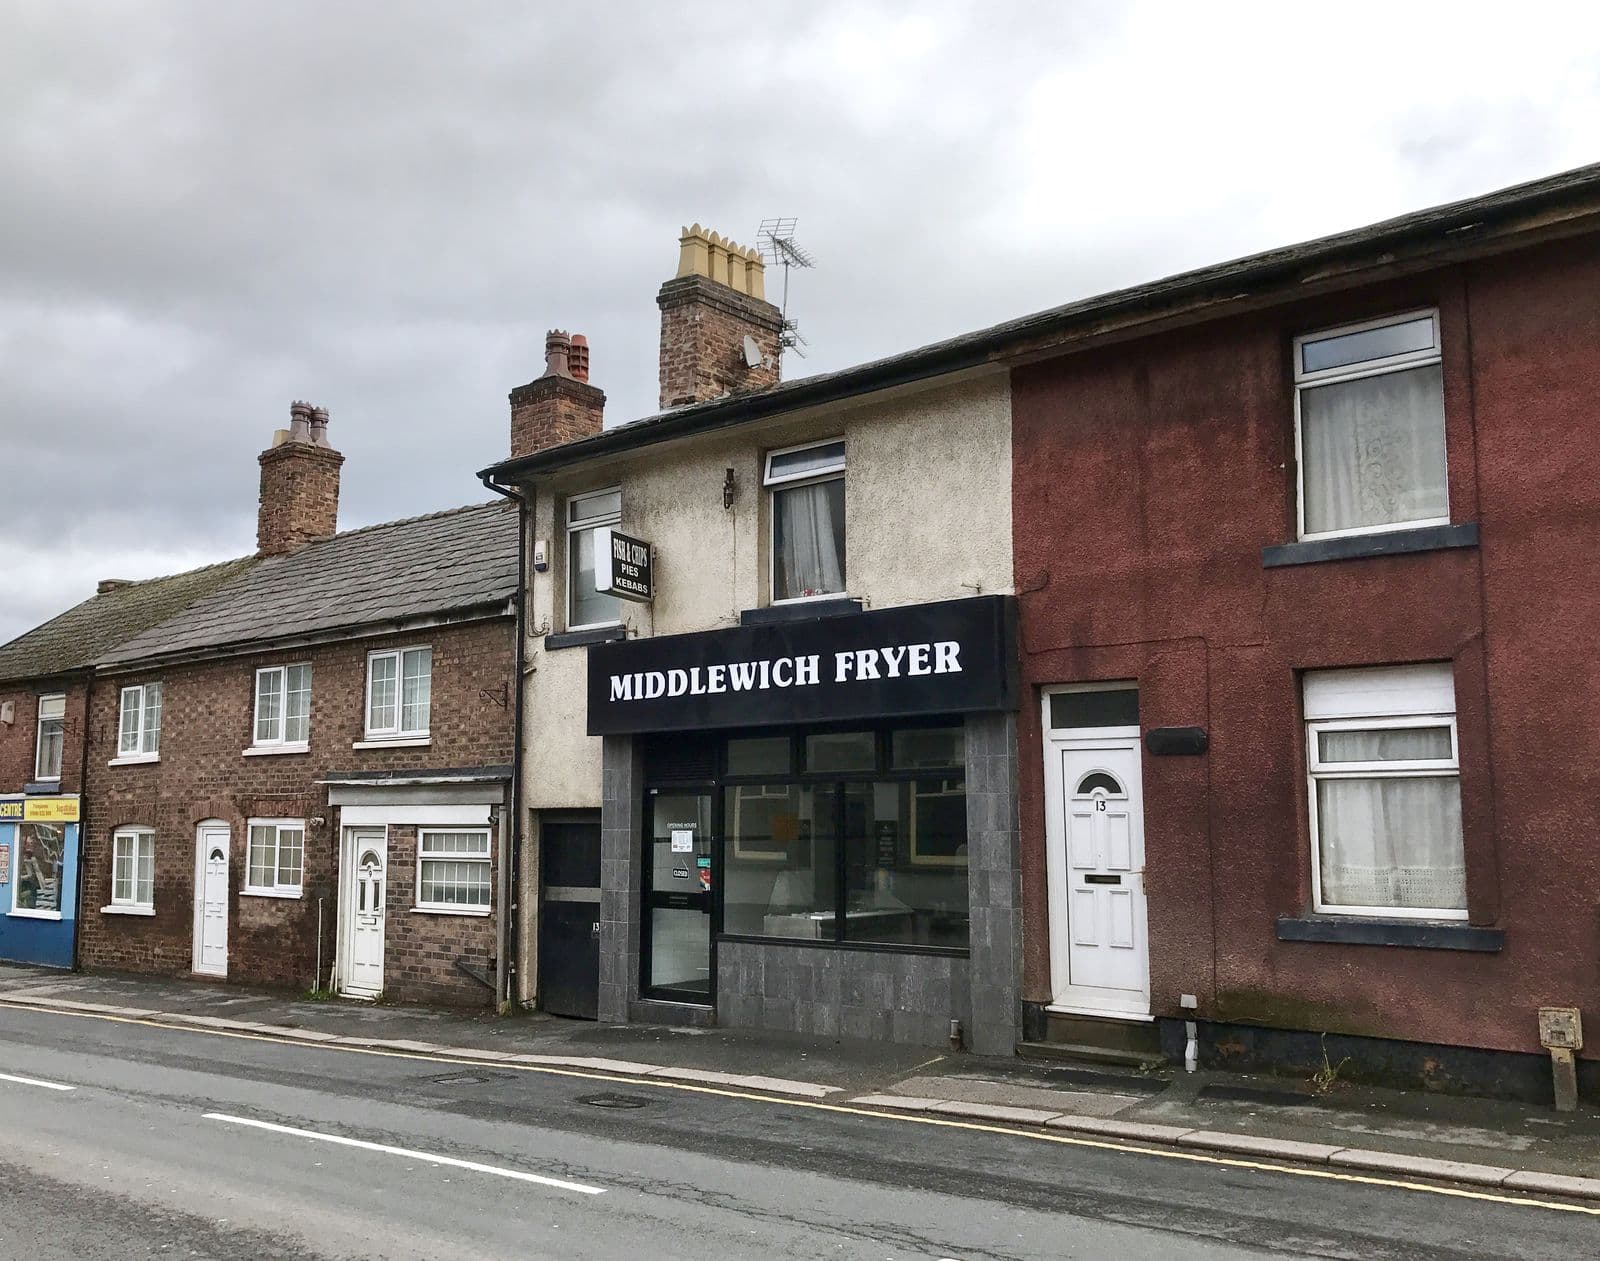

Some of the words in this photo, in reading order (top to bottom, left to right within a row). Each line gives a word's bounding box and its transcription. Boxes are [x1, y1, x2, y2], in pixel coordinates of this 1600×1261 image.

[613, 537, 626, 561] FISH
[626, 542, 631, 562] &
[632, 544, 648, 568] CHIPS
[621, 563, 639, 578] PIES
[615, 576, 648, 594] KEBABS
[609, 654, 820, 702] MIDDLEWICH
[834, 640, 963, 683] FRYER
[0, 803, 22, 817] CENTRE
[1095, 800, 1106, 812] 13
[592, 922, 600, 931] 13
